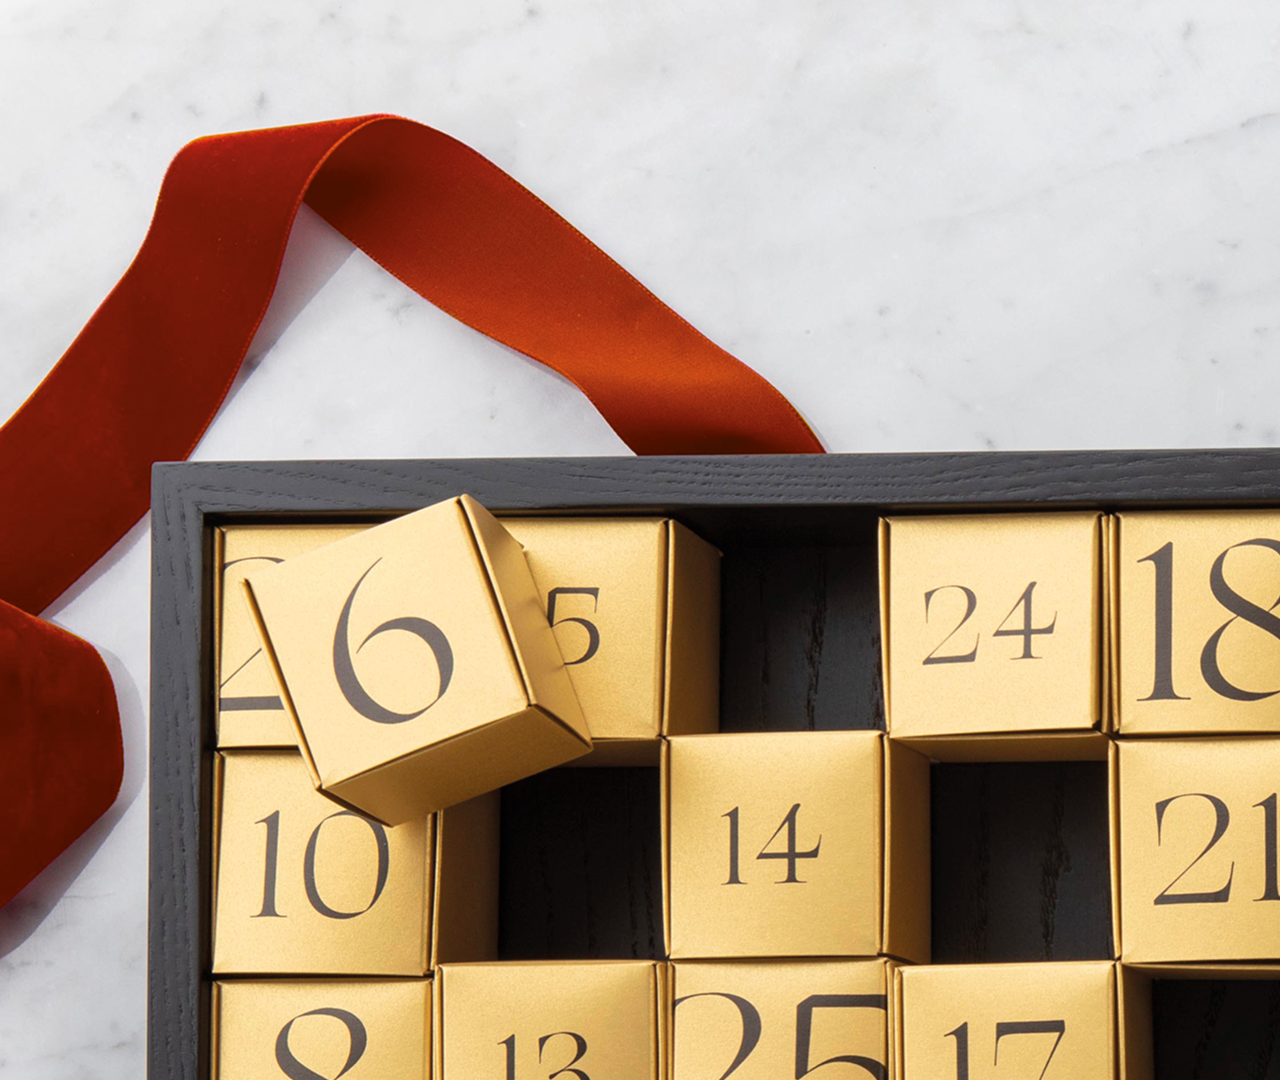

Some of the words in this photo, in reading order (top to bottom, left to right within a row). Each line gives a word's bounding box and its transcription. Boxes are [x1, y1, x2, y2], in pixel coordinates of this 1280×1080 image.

[333, 557, 454, 724] 6
[546, 587, 599, 666] 5
[922, 581, 1057, 665] 24
[250, 809, 390, 919] 10
[723, 804, 820, 884] 14
